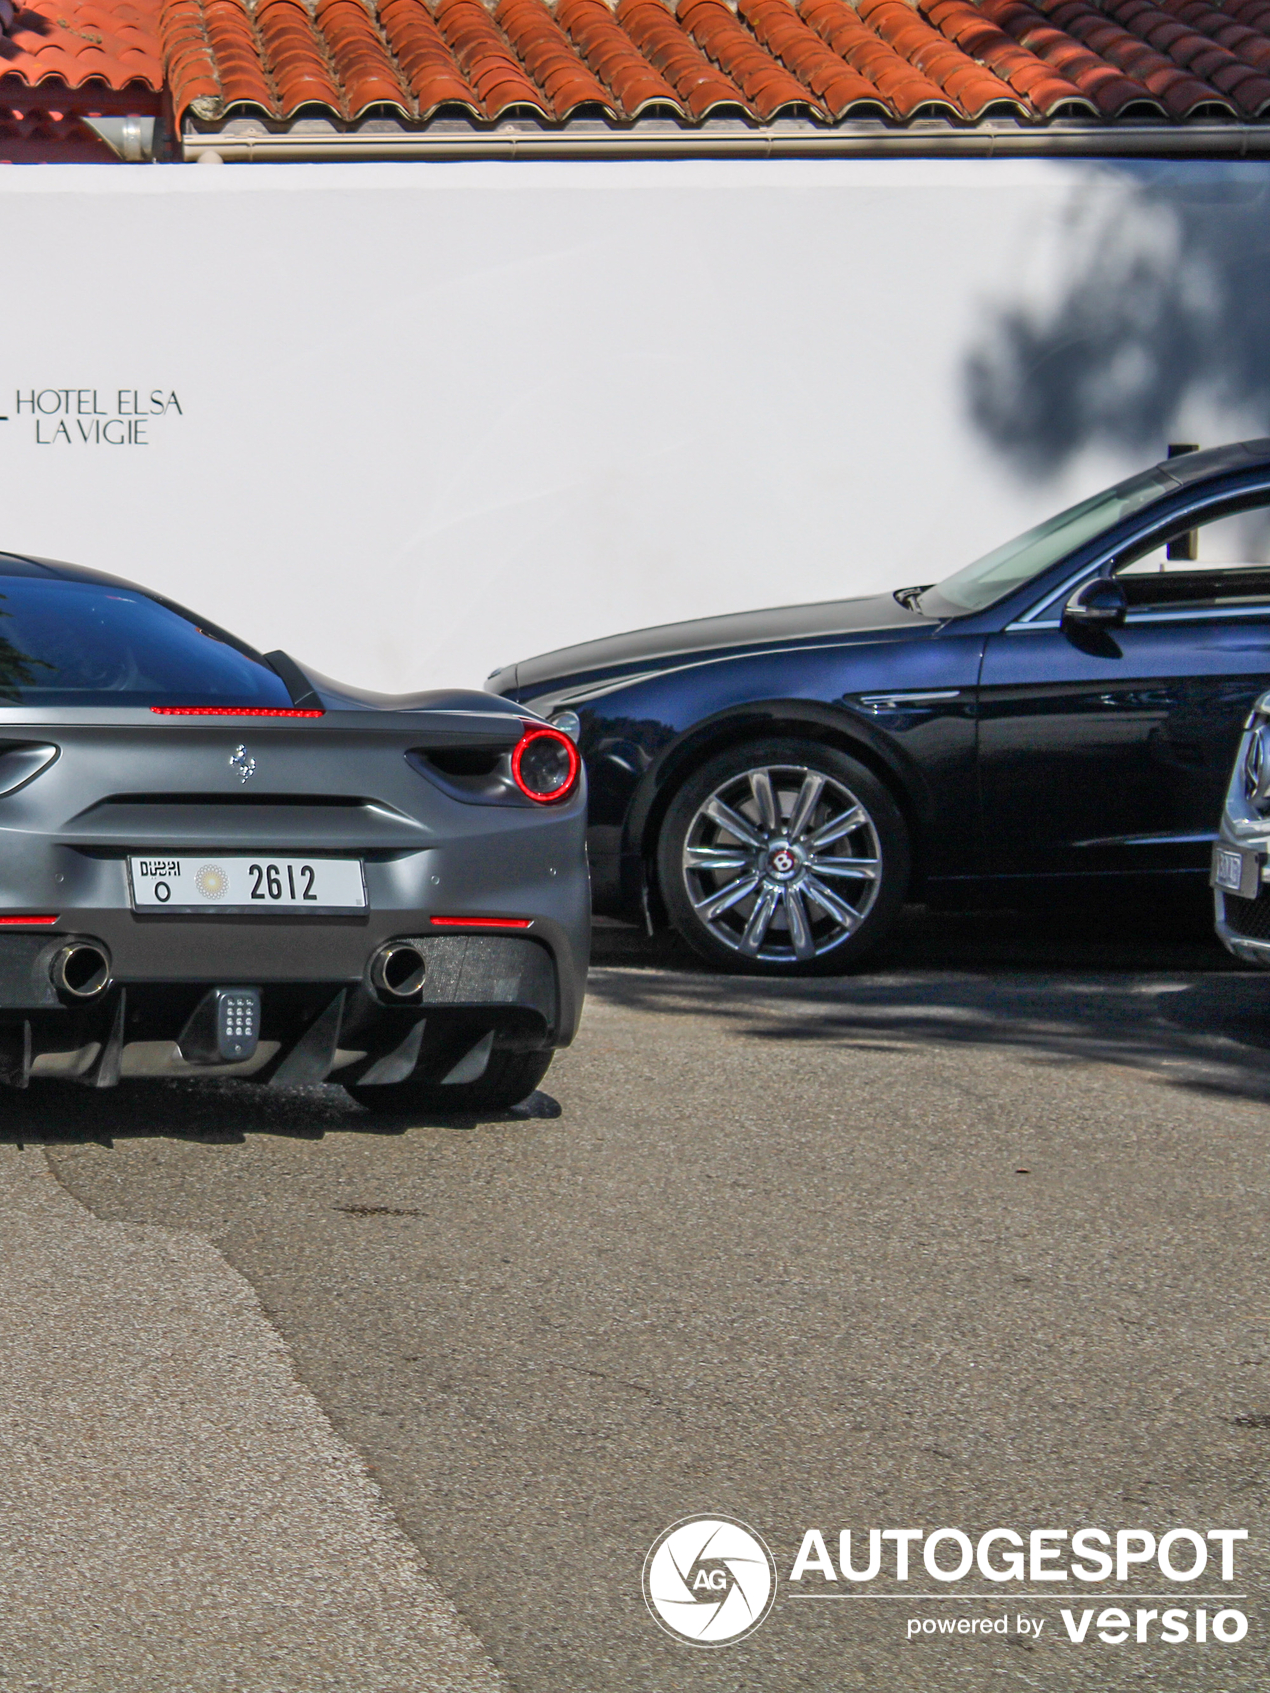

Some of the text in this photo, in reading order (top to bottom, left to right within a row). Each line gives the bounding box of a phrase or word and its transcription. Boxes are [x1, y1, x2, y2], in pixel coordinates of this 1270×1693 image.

[16, 389, 183, 415] HOTEL ELSA
[36, 419, 149, 444] LA VIGIE
[249, 864, 317, 900] 2612
